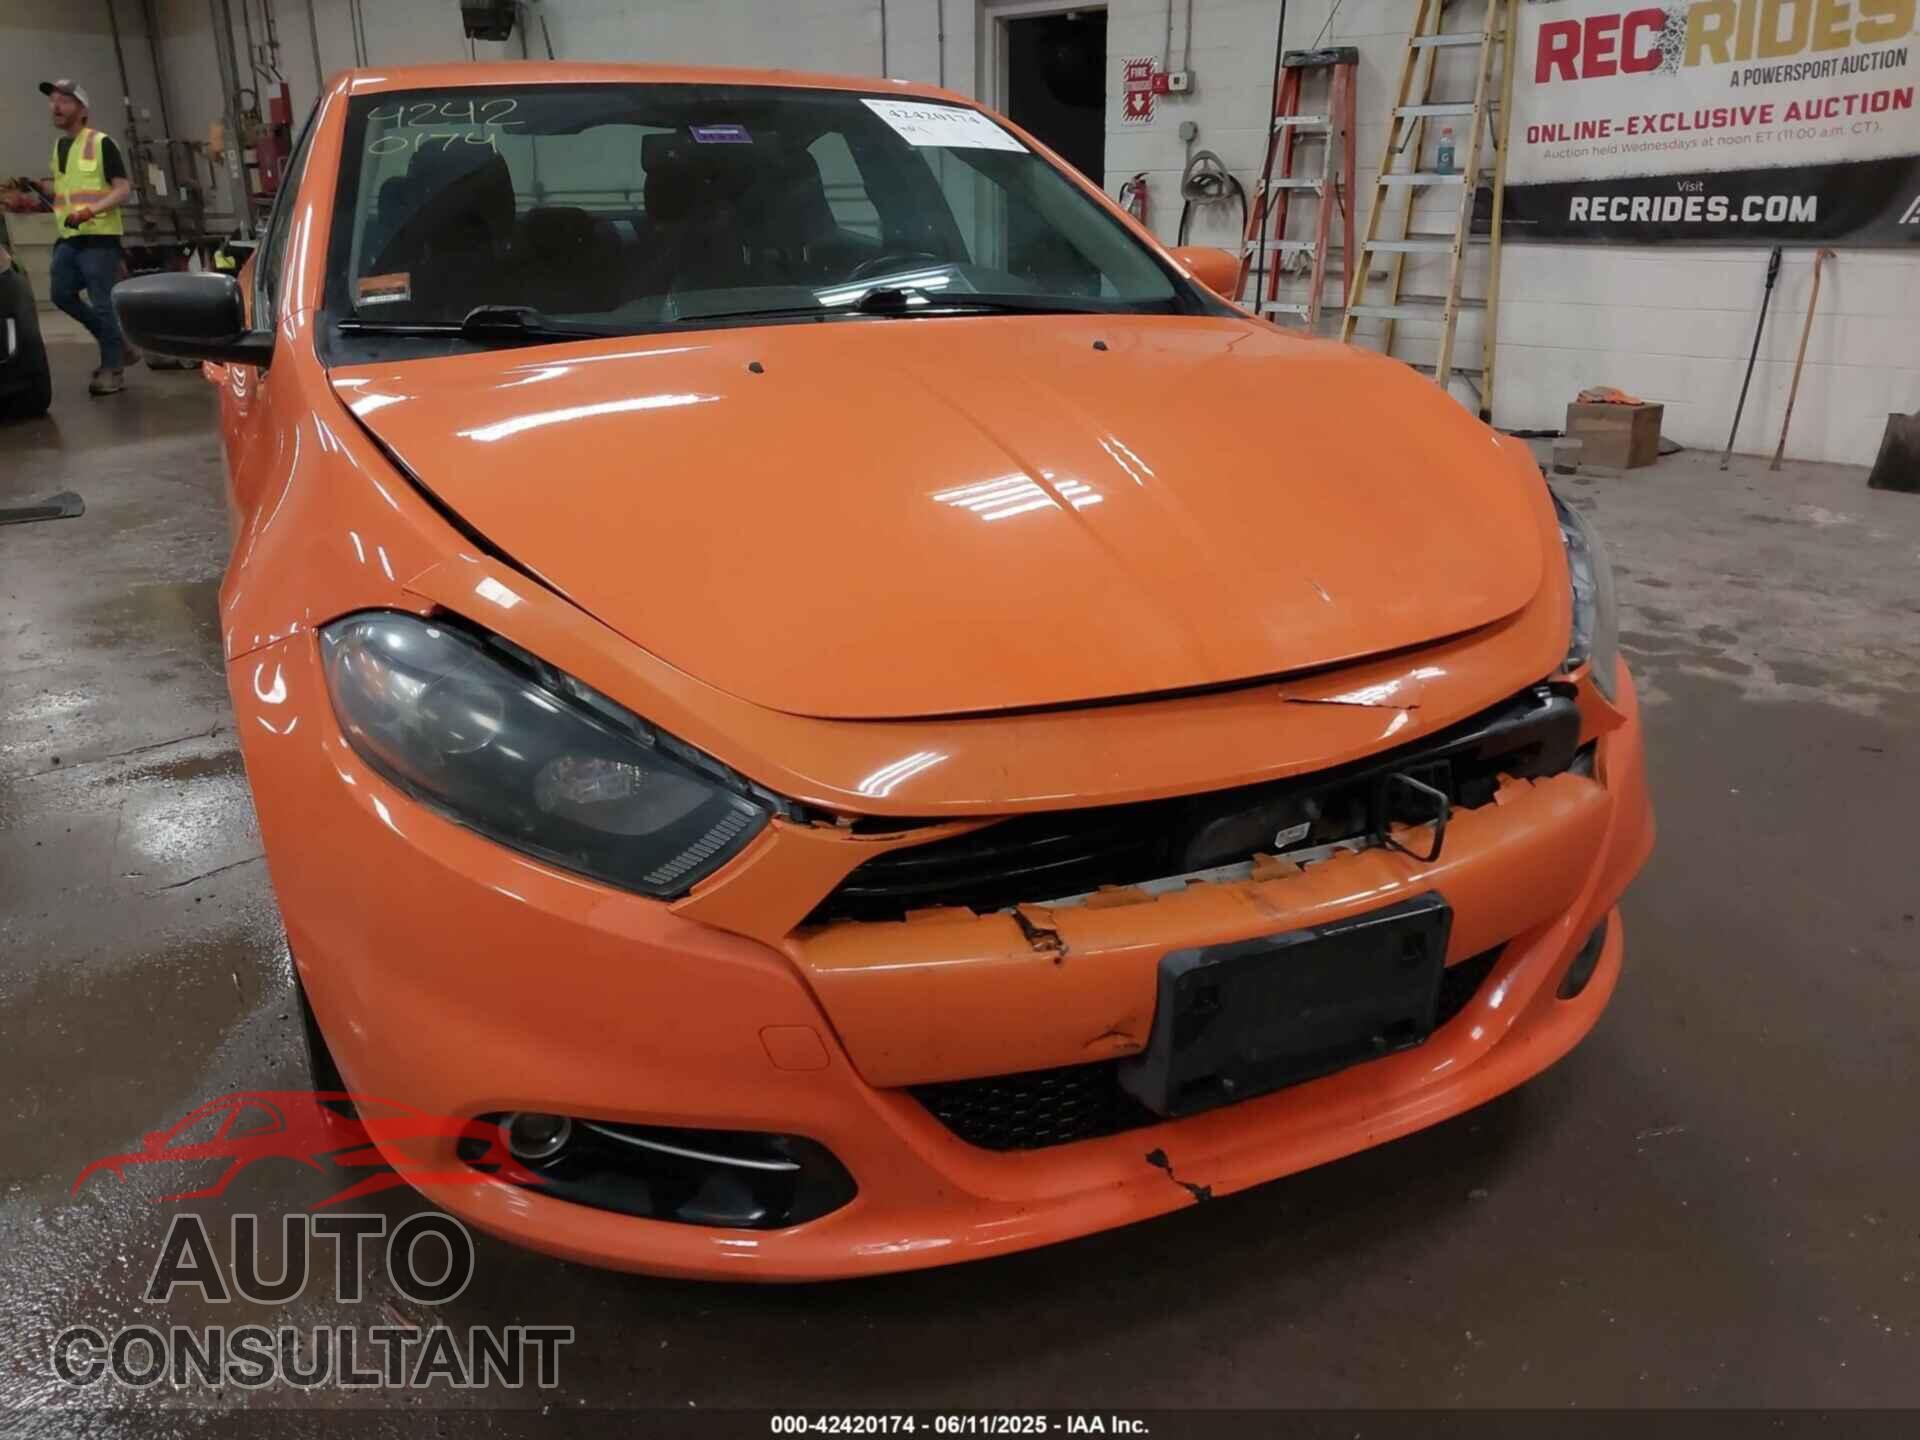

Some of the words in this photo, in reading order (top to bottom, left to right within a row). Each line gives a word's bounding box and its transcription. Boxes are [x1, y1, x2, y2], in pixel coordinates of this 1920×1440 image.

[1535, 8, 1667, 84] REC
[1683, 0, 1917, 67] RIDES
[1730, 70, 1740, 88] A
[1743, 58, 1838, 87] POWERSPORT
[1840, 48, 1908, 75] AUCTION
[367, 98, 526, 128] 4242
[1527, 104, 1774, 144] ONLINE-EXCLUSIVE
[1784, 87, 1914, 122] AUCTION
[368, 132, 498, 154] 0174
[1544, 145, 1589, 159] Auction
[1592, 142, 1618, 155] held
[1620, 138, 1697, 153] Wednesdays
[1701, 136, 1714, 147] at
[1716, 134, 1751, 146] noon
[1756, 131, 1774, 144] ET
[1676, 180, 1704, 193] Visit
[1569, 195, 1817, 223] RECRIDES.COM
